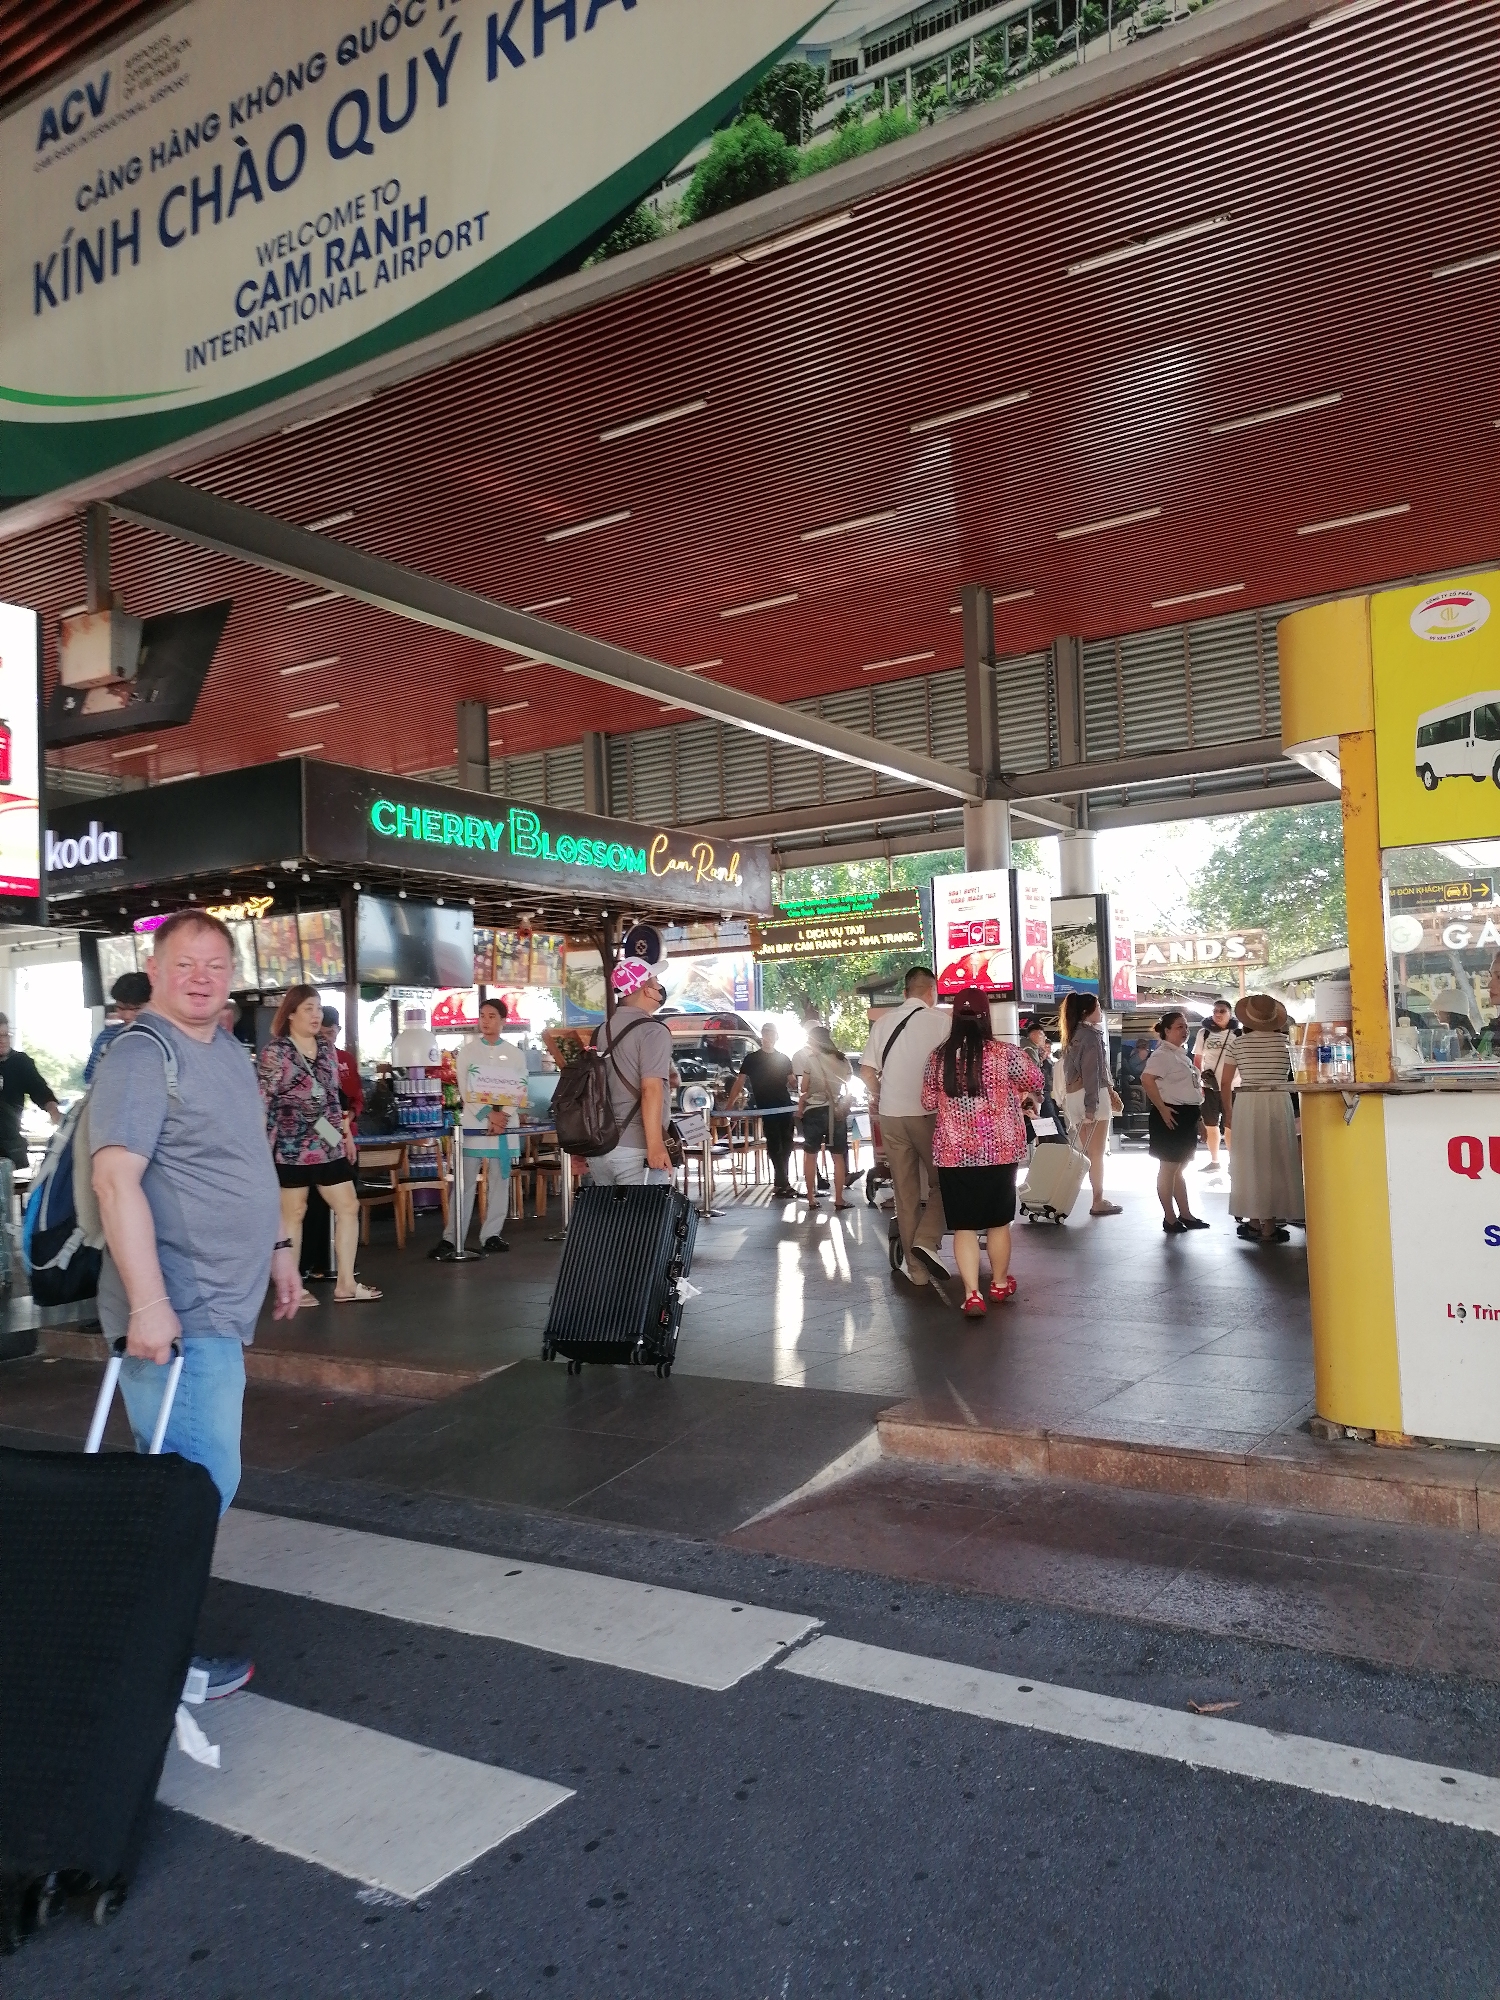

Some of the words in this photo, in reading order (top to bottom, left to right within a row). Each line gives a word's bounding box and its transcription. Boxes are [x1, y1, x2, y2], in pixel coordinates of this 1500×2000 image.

[36, 70, 112, 154] ACV
[150, 113, 221, 173] HÀNG
[229, 52, 328, 129] KHÔNG
[33, 208, 141, 317] KÍNH
[157, 123, 308, 249] CHÀO
[326, 15, 463, 161] QUÝ
[234, 251, 311, 318] CAM
[324, 195, 428, 279] RANH
[256, 195, 366, 267] WELCOME
[371, 178, 401, 211] TO
[185, 270, 368, 373] INTERNATIONAL
[374, 210, 490, 290] AIRPORT
[370, 799, 505, 853] CHERRY
[509, 807, 647, 876] BLOSSOM
[650, 833, 694, 878] Cam
[691, 842, 743, 887] Ranh
[794, 940, 814, 952] CAM
[815, 939, 842, 951] RANH
[859, 935, 880, 947] NHA
[843, 924, 866, 936] TAXI
